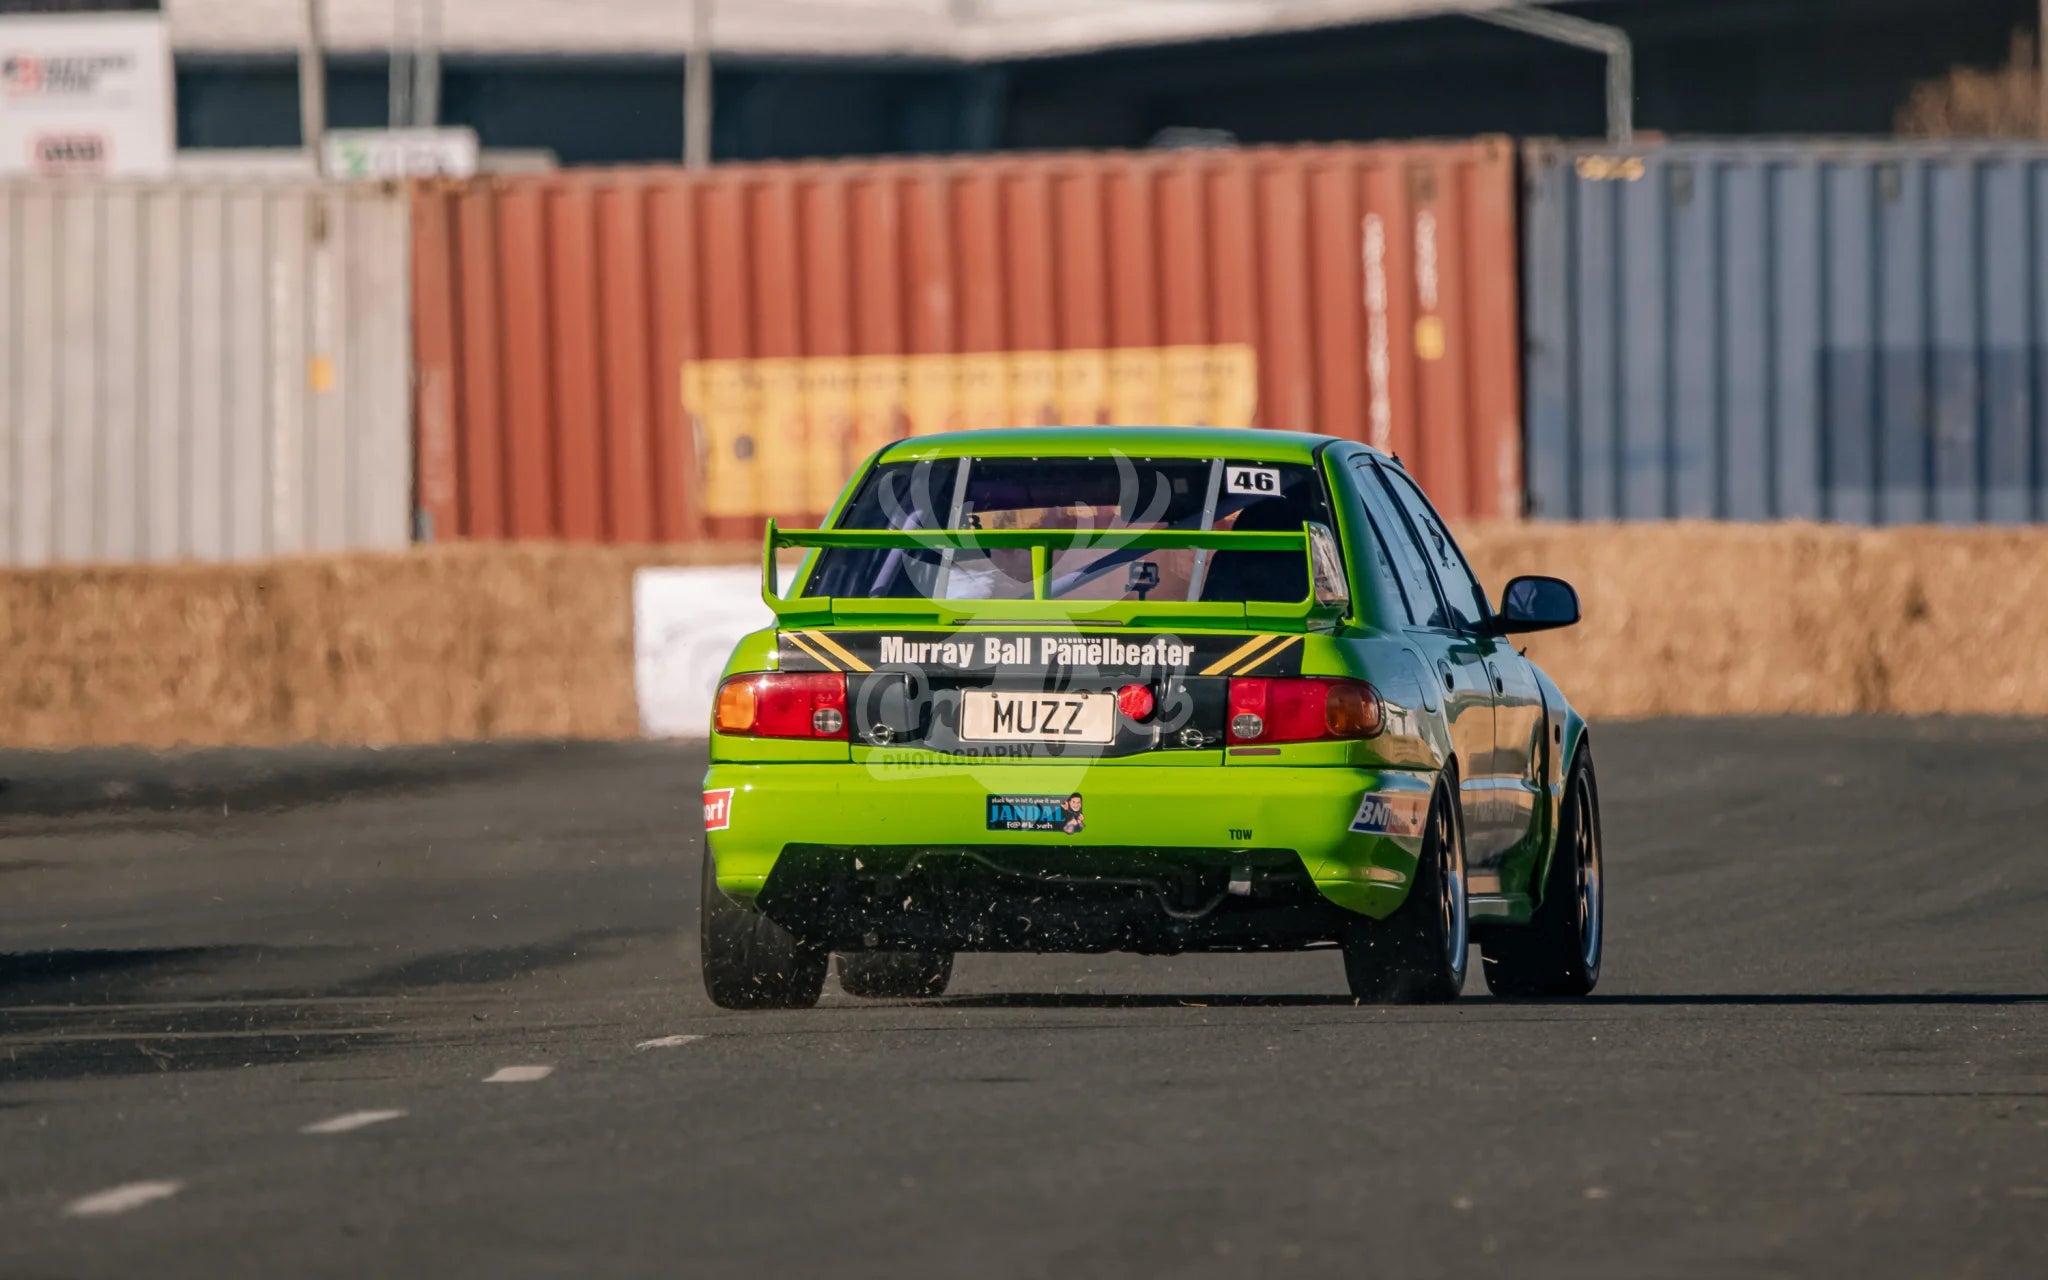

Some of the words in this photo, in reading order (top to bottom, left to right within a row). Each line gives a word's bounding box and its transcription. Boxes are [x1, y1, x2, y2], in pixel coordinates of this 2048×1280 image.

[1234, 471, 1274, 491] 46
[880, 636, 974, 668] Murray
[984, 637, 1031, 665] Ball
[1041, 638, 1195, 667] Panelbeater
[993, 700, 1084, 735] MUZZ
[990, 805, 1065, 822] JANDAL
[1229, 829, 1252, 840] TOW
